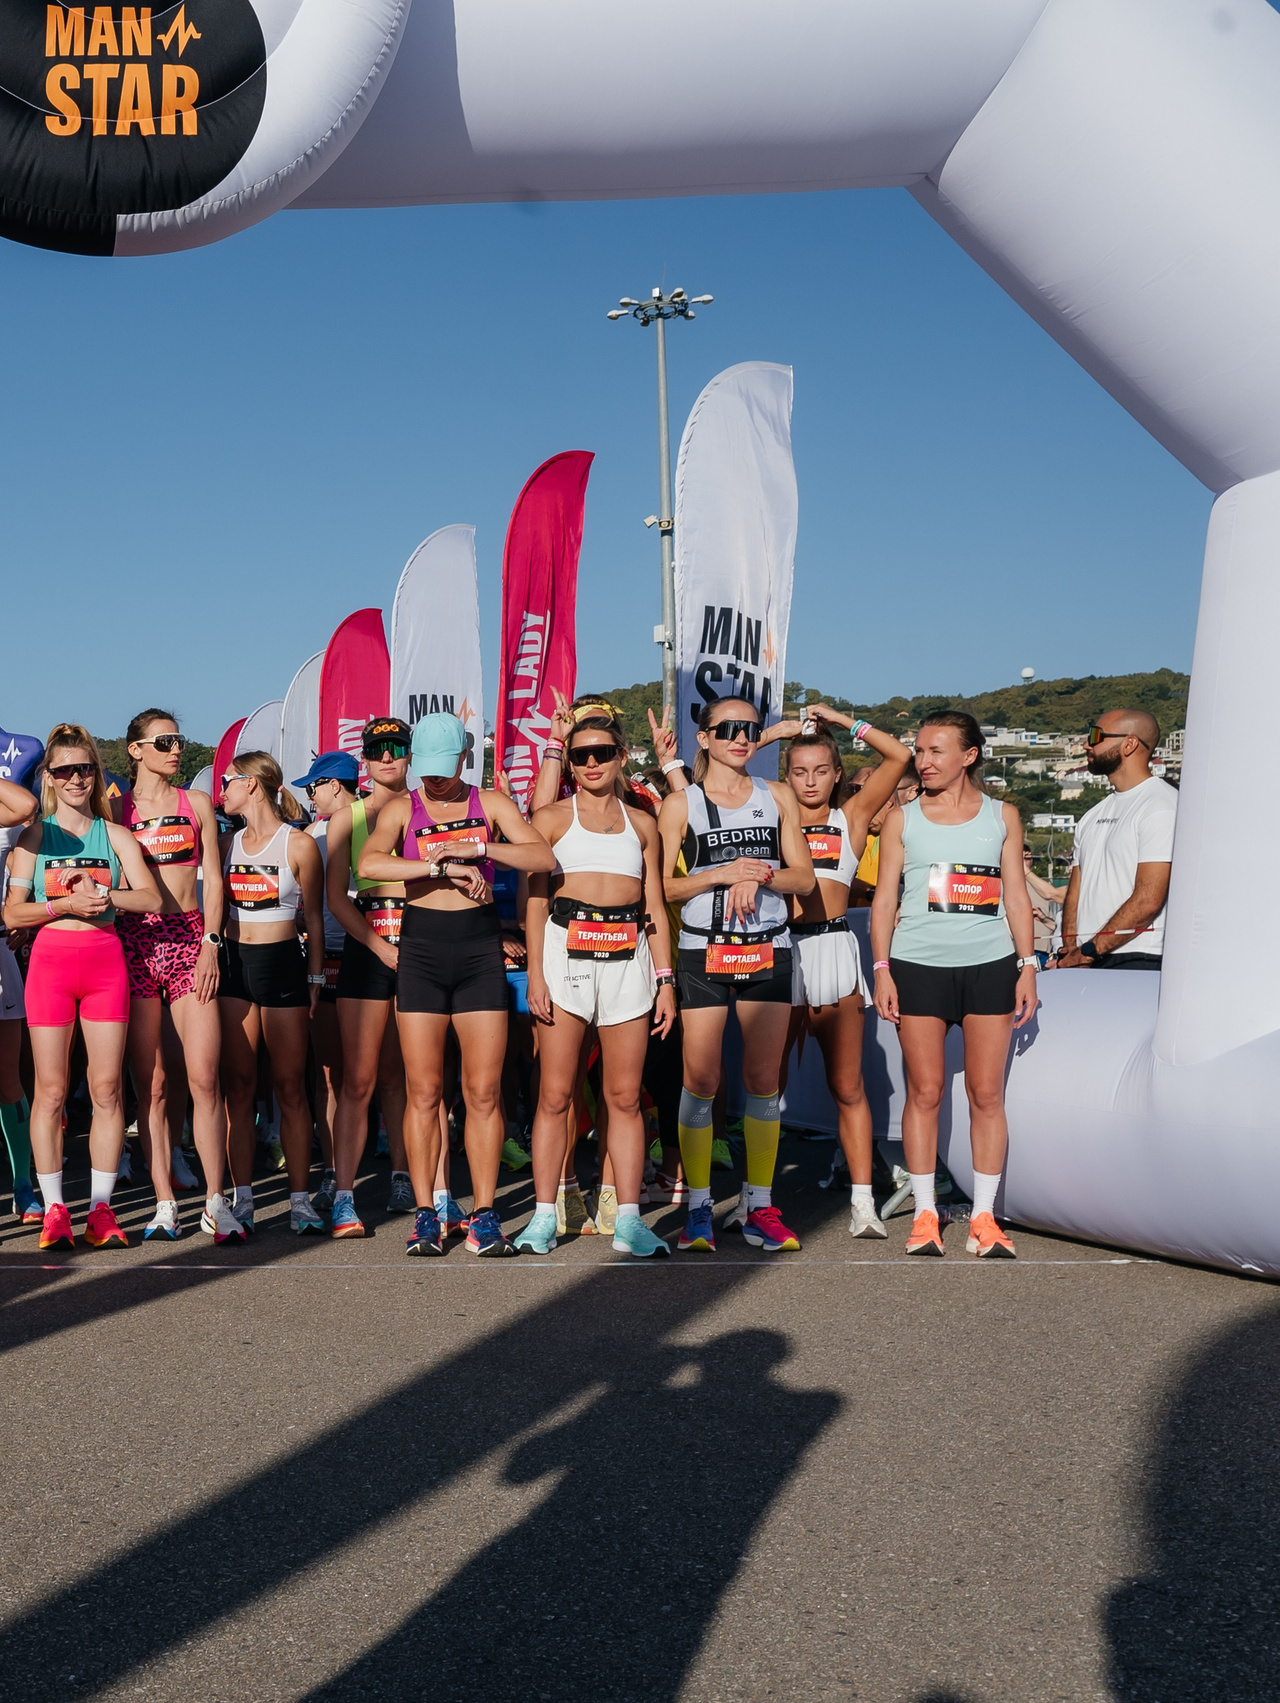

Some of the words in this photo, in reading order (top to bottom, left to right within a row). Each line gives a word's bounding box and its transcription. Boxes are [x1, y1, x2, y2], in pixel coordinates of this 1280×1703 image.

[45, 4, 152, 57] MAN
[45, 63, 200, 136] STAR
[508, 610, 545, 700] LADY
[142, 834, 185, 846] ЖИГУНОВА
[706, 828, 771, 847] BEDRIK
[738, 846, 770, 856] team
[230, 882, 268, 892] МИКУШЕВА
[952, 884, 982, 894] ТОПОР
[577, 931, 628, 941] ТЕРЕНТЬЕВА
[722, 953, 761, 963] ЮРТАЕВА
